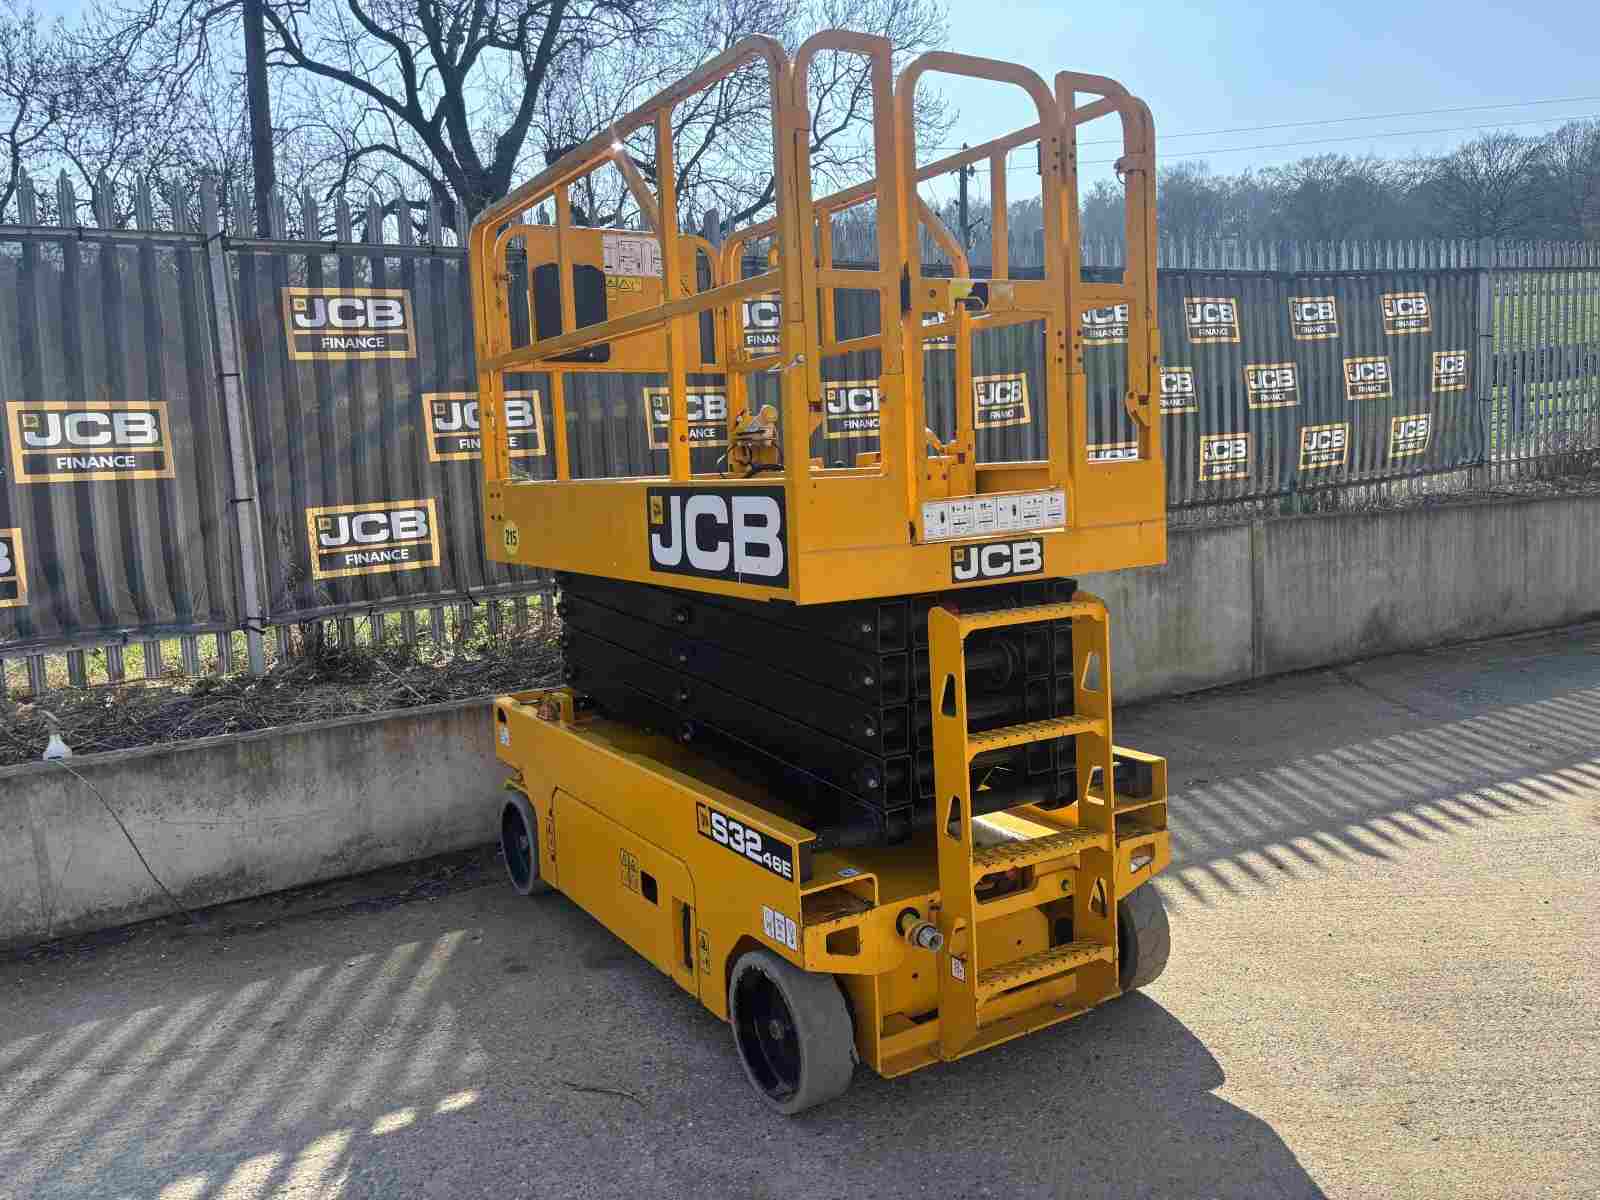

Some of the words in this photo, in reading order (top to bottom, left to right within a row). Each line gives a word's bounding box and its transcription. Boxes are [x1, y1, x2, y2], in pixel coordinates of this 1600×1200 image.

[294, 298, 404, 328] JCB
[1188, 304, 1233, 323] JCB
[1296, 303, 1333, 321] JCB
[1385, 299, 1427, 317] JCB
[321, 337, 385, 348] FINANCE
[747, 334, 780, 345] FINAN
[1350, 362, 1386, 381] JCB
[1436, 357, 1464, 374] JCB
[1161, 373, 1193, 393] CB
[1250, 370, 1295, 389] JCB
[980, 381, 1022, 405] JCB
[23, 412, 159, 448] JCB
[843, 419, 880, 430] FINANC
[1393, 420, 1427, 439] JCB
[1307, 430, 1345, 450] JCB
[1205, 440, 1246, 461] JCB
[56, 455, 136, 470] FINANCE
[319, 510, 429, 546] JCB
[651, 495, 784, 577] JCB
[345, 549, 409, 565] FINANCE
[954, 541, 1042, 580] JCB
